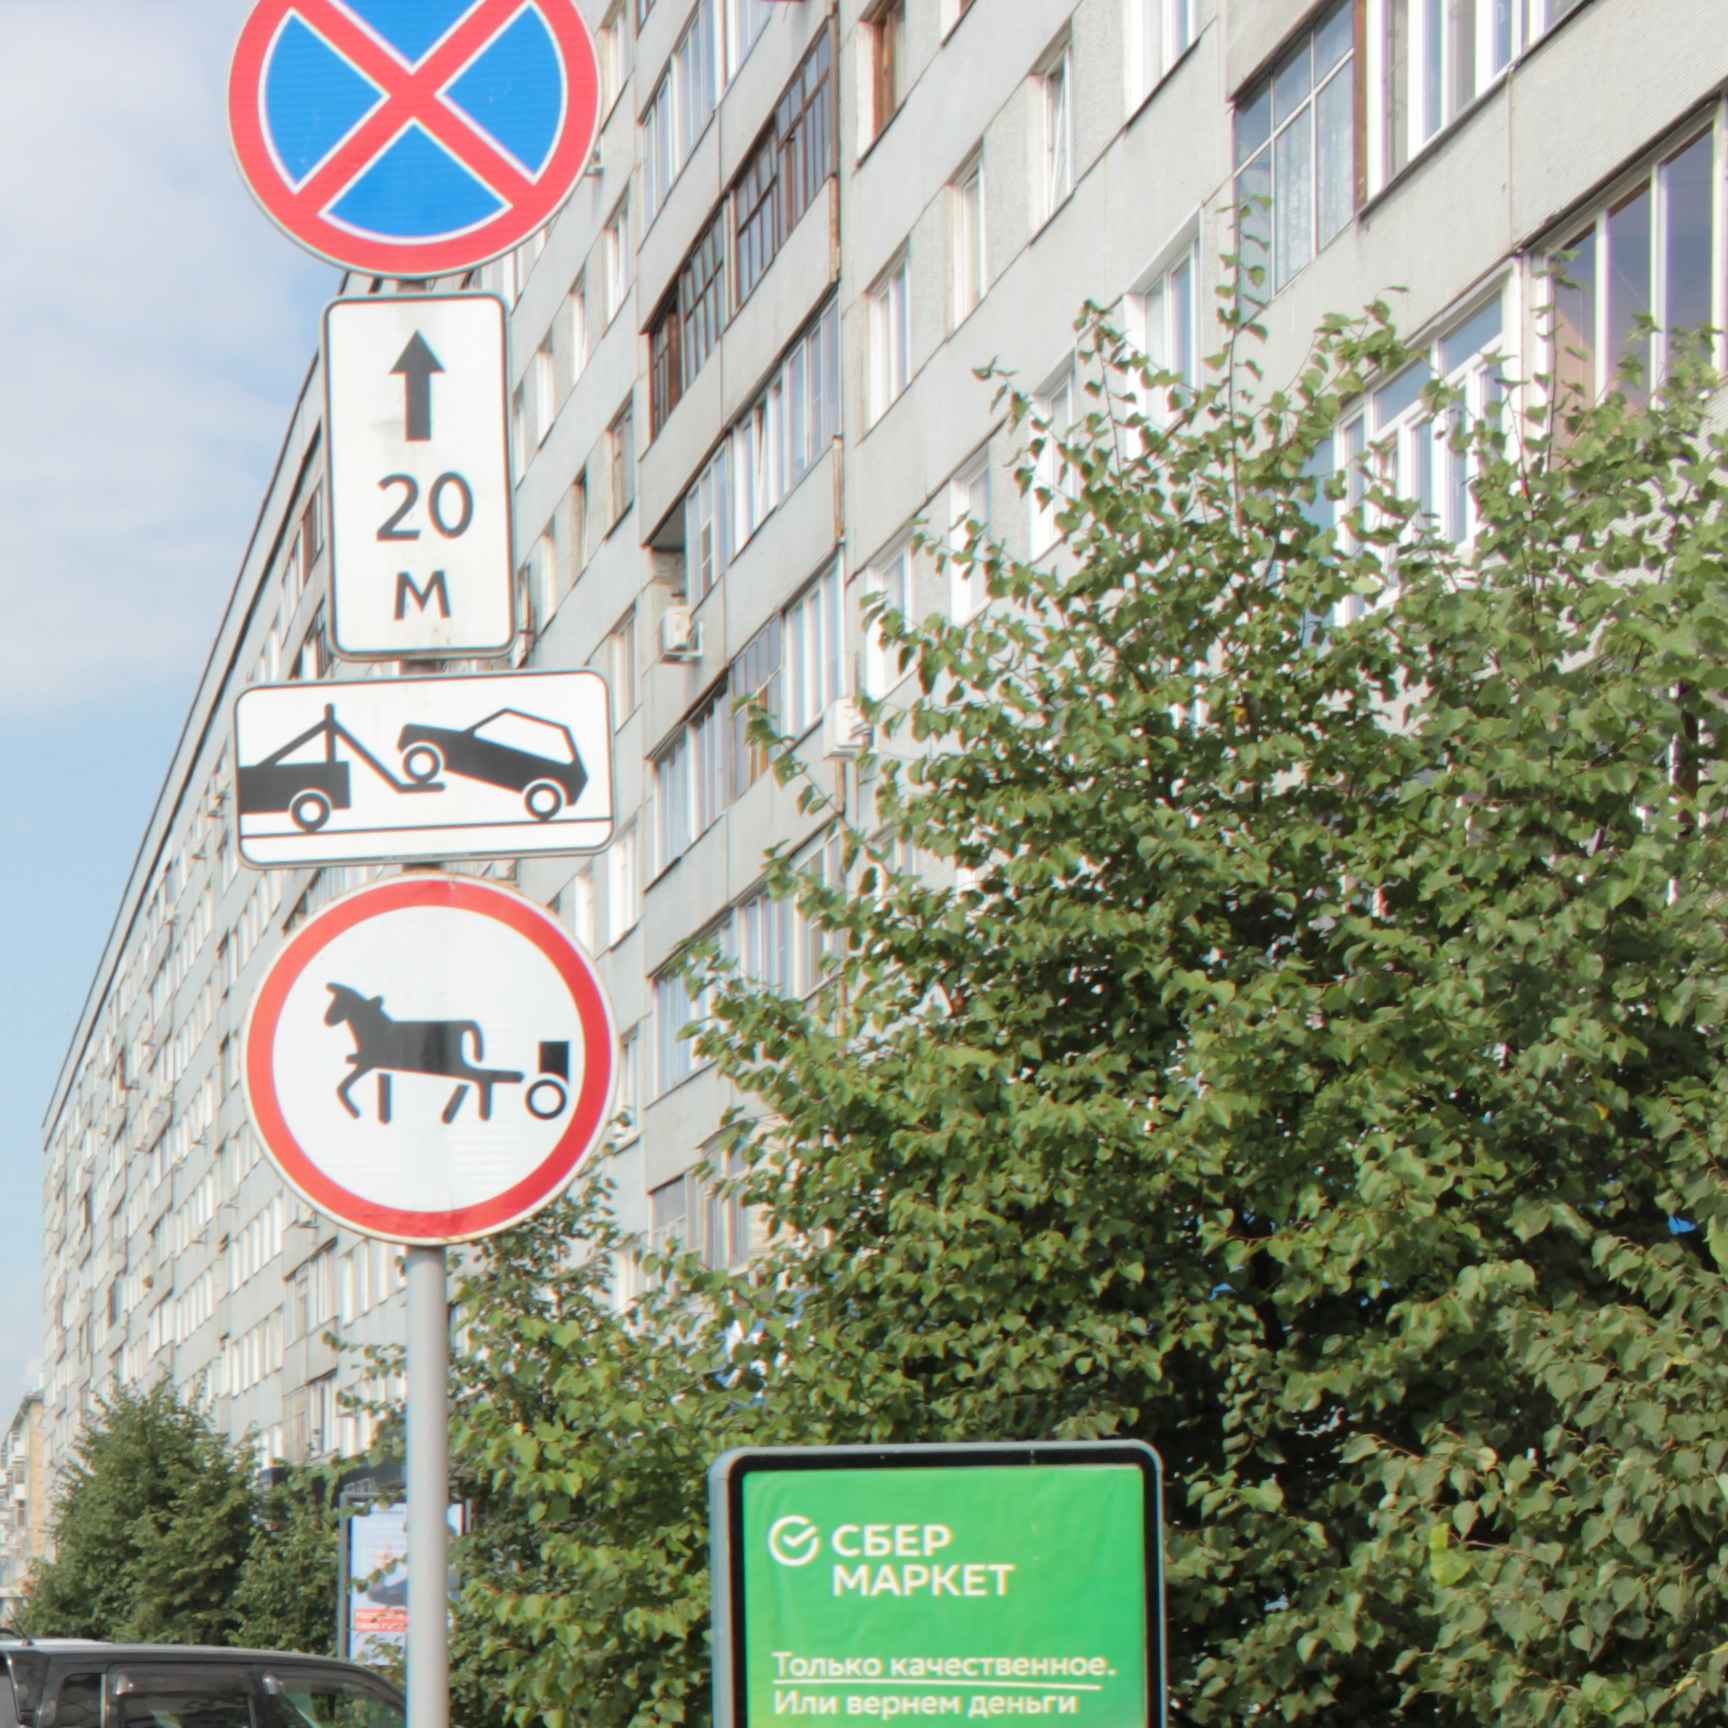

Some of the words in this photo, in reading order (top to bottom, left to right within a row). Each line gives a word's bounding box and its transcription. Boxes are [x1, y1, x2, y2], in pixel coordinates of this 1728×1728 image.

[376, 470, 474, 542] 20
[831, 1523, 953, 1558] СБЕР
[832, 1563, 1015, 1597] МАРКЕТ
[772, 1651, 883, 1679] Только
[890, 1654, 1118, 1678] качественное.
[772, 1690, 838, 1716] Или
[845, 1695, 961, 1720] вернем
[967, 1694, 1080, 1719] деньги
